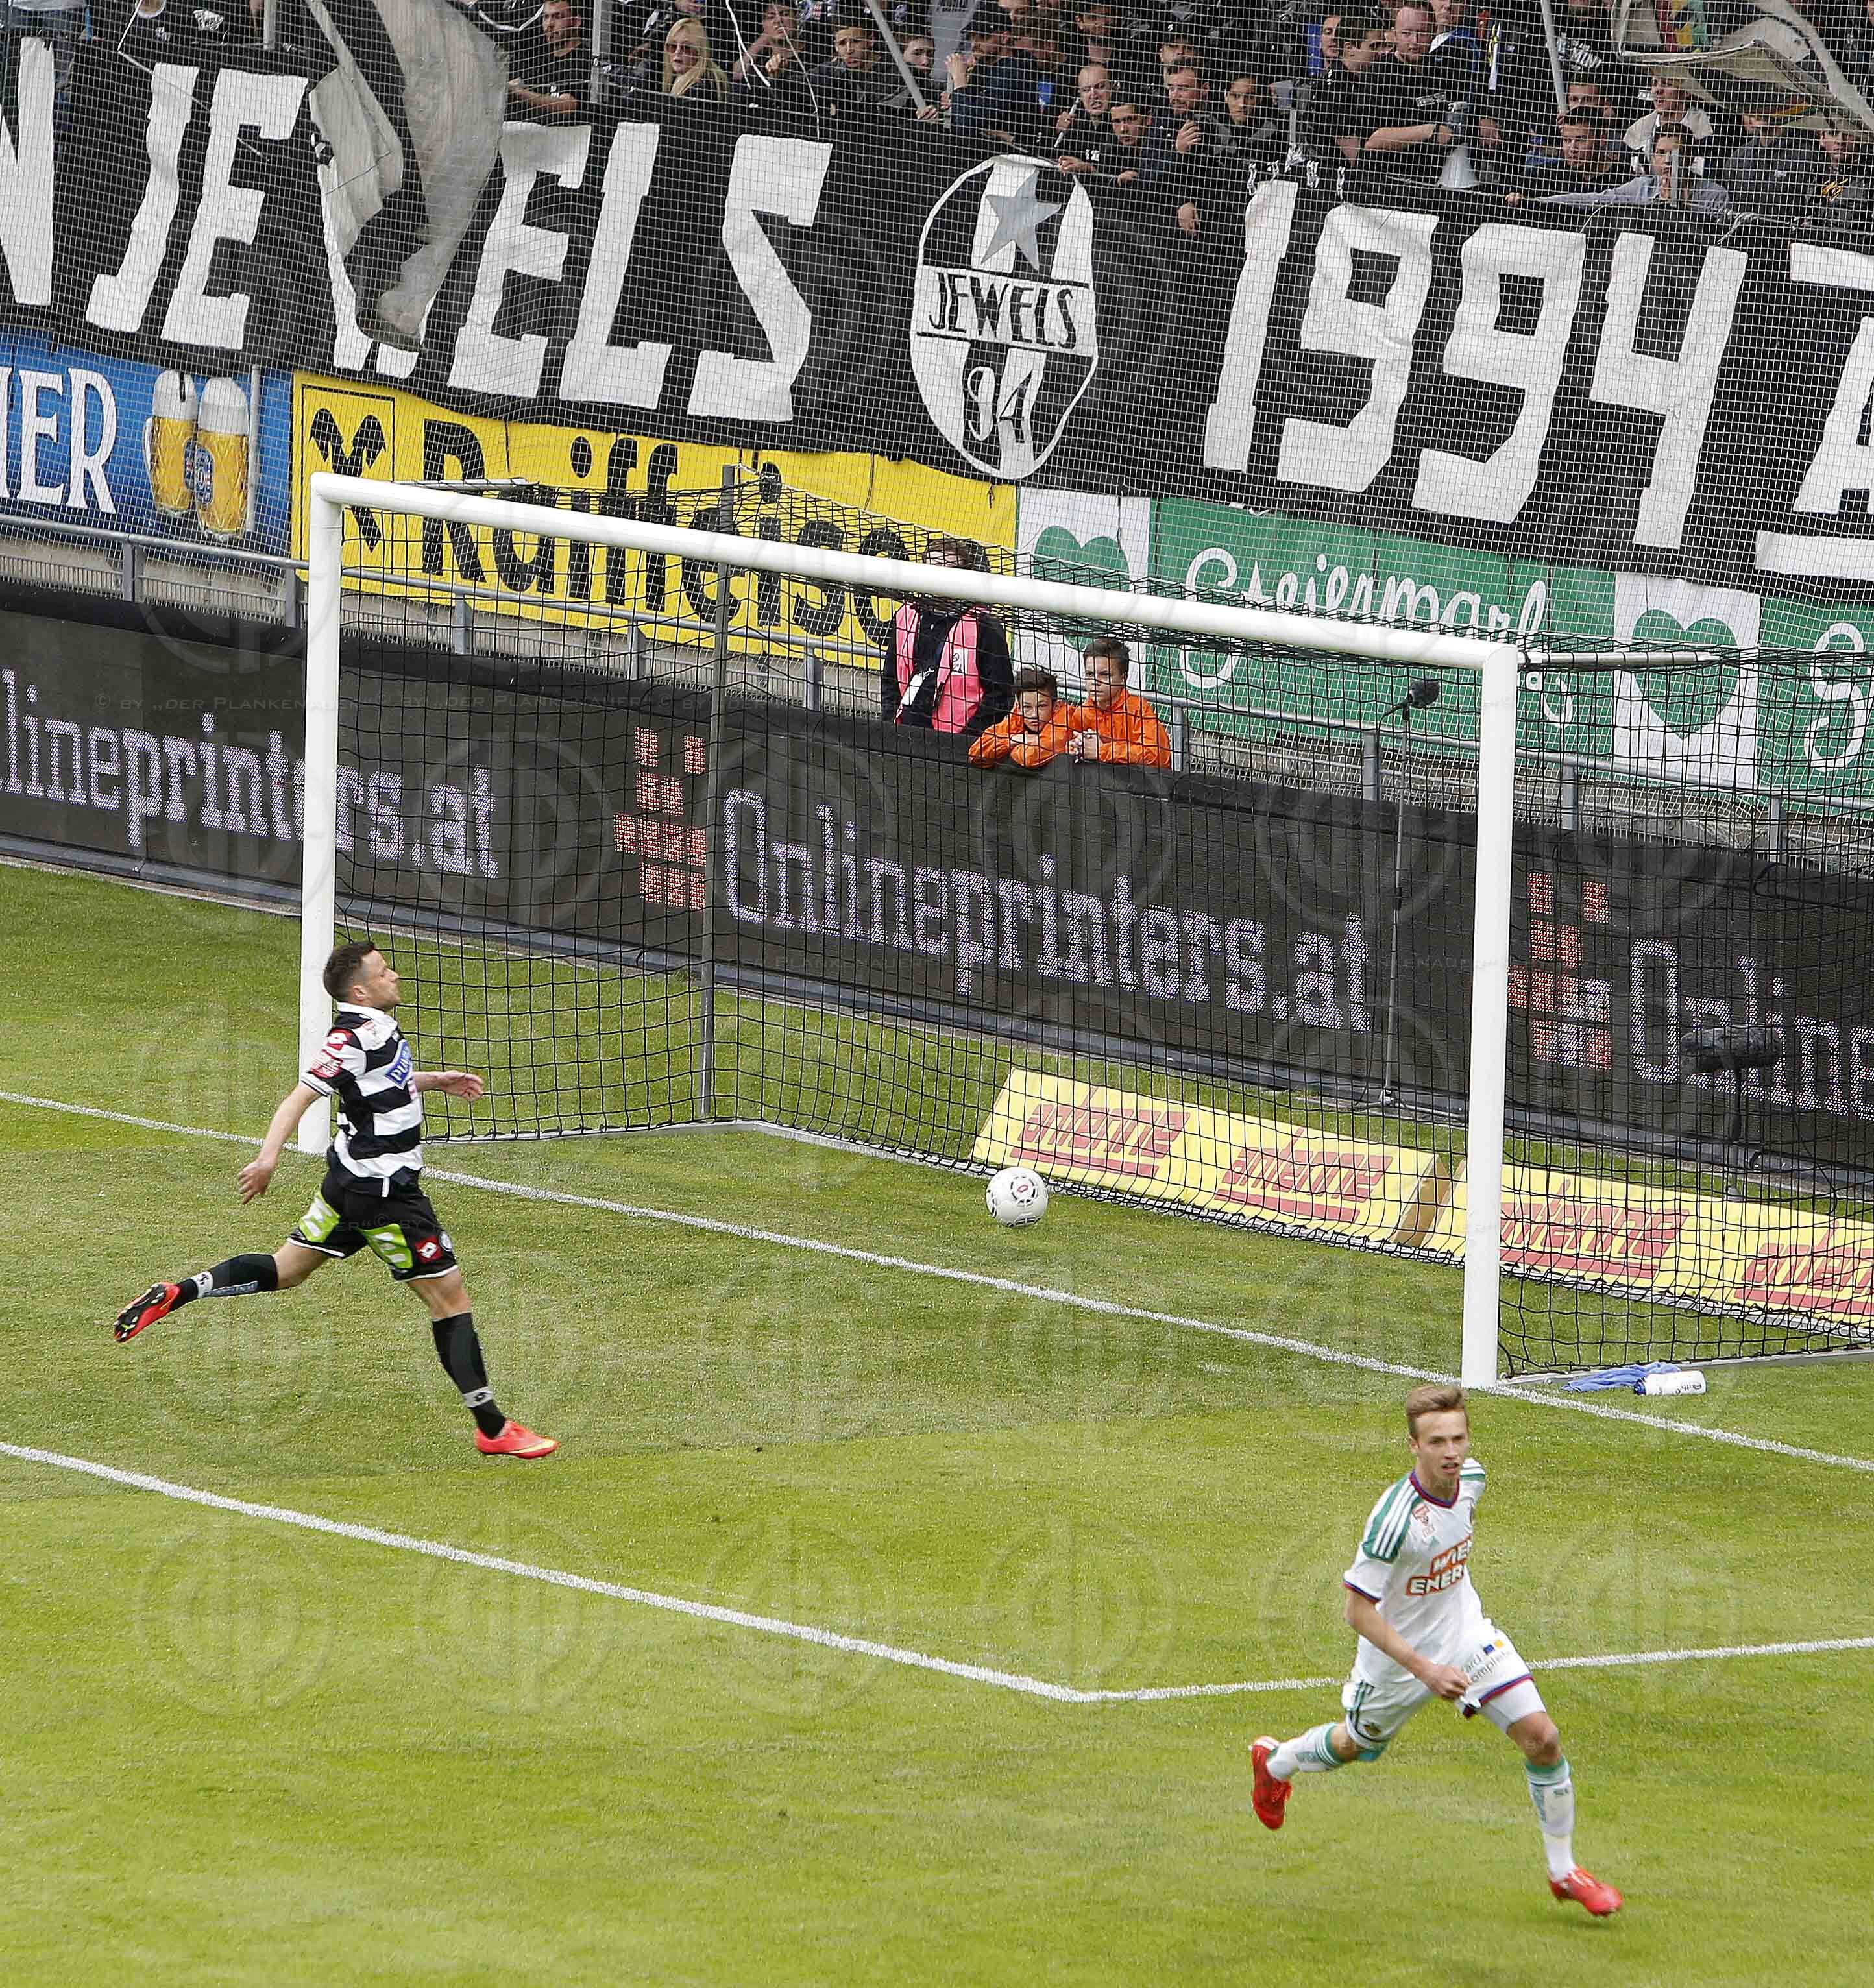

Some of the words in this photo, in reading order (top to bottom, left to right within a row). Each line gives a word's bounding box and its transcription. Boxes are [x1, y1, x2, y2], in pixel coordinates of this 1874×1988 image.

[929, 269, 1077, 350] JEWELS
[967, 366, 1033, 444] 94
[1204, 180, 1748, 550] 1994
[422, 418, 990, 649] Raiffeise
[0, 668, 498, 880] lineprintrs.at
[722, 788, 1372, 1034] Onlineprinters.at
[1017, 1086, 1190, 1159] antenne
[1221, 1126, 1394, 1202] antenne
[1500, 1179, 1690, 1258] ntenne
